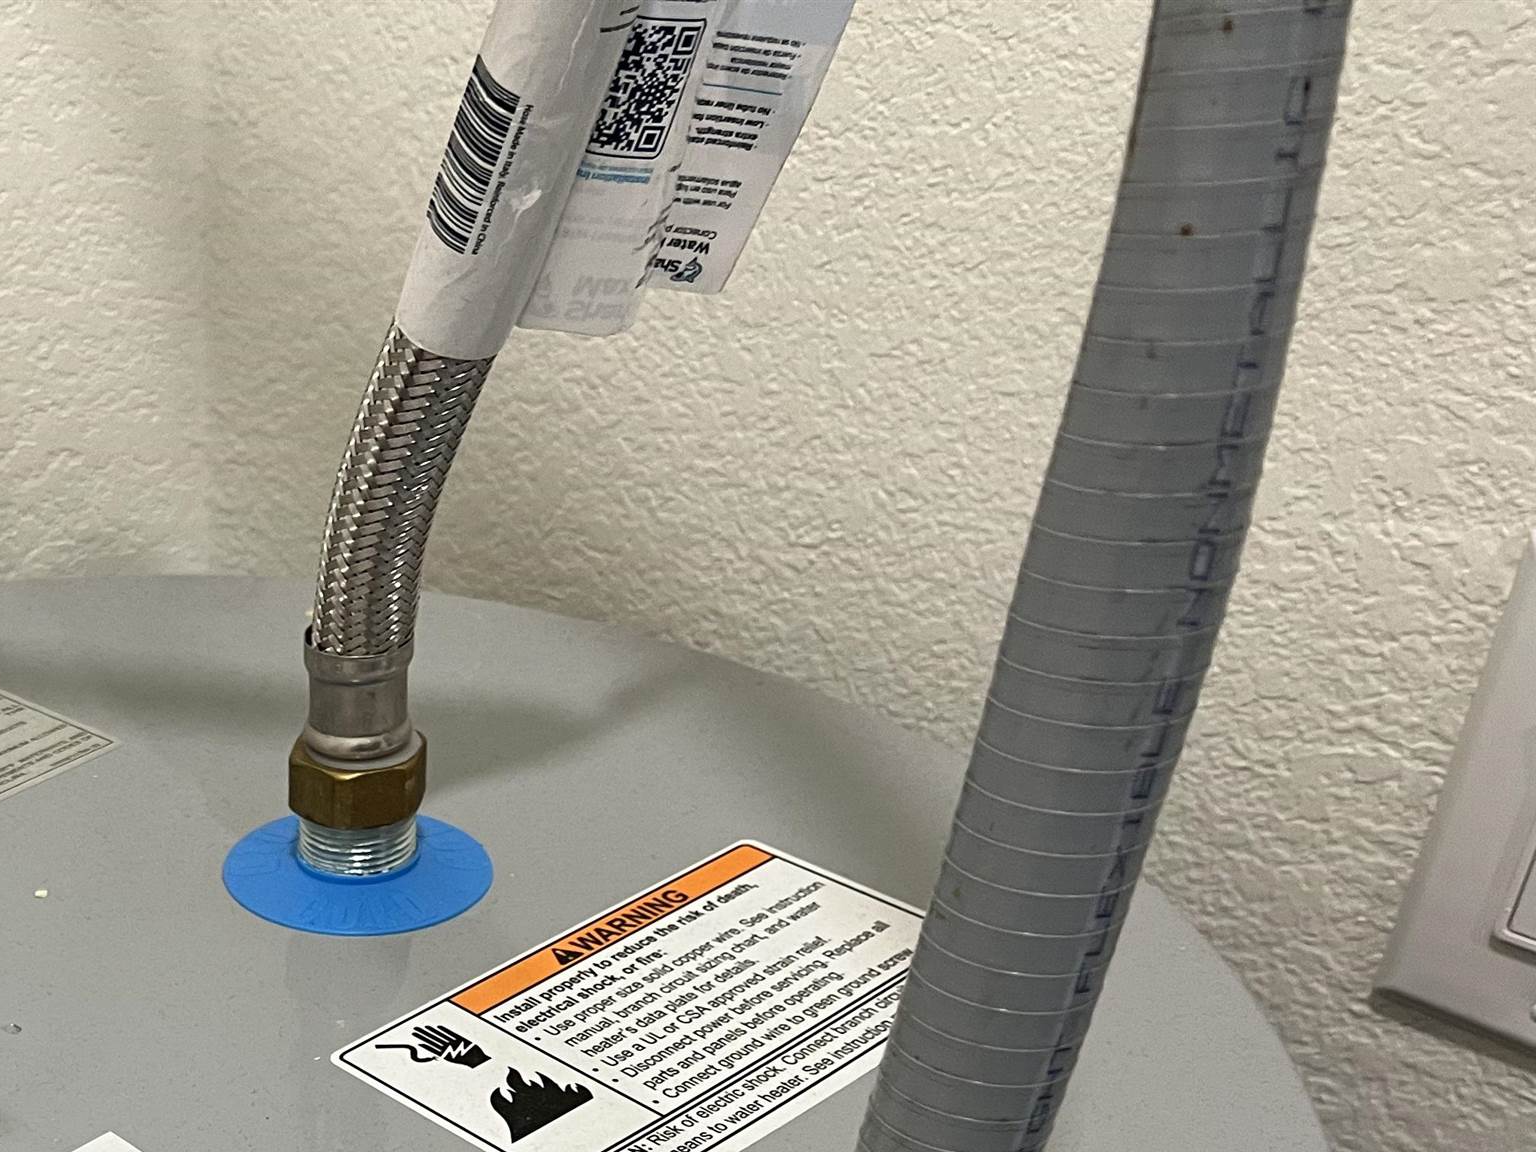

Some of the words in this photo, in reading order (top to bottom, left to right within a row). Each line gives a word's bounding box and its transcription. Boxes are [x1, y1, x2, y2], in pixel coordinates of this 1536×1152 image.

[667, 238, 710, 255] Water
[493, 996, 541, 1023] Install
[538, 967, 598, 1001] properly
[592, 959, 612, 969] to
[610, 935, 657, 961] reduce
[652, 923, 679, 937] the
[676, 910, 705, 925] risk
[701, 900, 719, 911] of
[716, 883, 759, 903] death,
[569, 889, 688, 950] WARNING
[795, 936, 831, 956] relief.
[515, 995, 579, 1032] electrical
[576, 974, 626, 999] shock,
[621, 963, 639, 974] or
[634, 948, 668, 965] fire:
[542, 1019, 576, 1035] Use
[573, 995, 616, 1022] proper
[615, 981, 644, 998] size
[641, 963, 674, 983] solid
[671, 941, 714, 966] copper
[711, 927, 744, 943] wire.
[738, 912, 769, 927] See
[762, 881, 825, 913] instruction
[564, 1016, 620, 1047] manual,
[611, 992, 662, 1018] branch
[659, 970, 699, 993] circuit
[695, 951, 736, 973] sizing
[730, 933, 769, 953] chart,
[763, 918, 790, 934] and
[786, 901, 820, 921] water
[707, 972, 765, 1007] approved
[762, 954, 799, 975] strain
[580, 1026, 638, 1057] heater's
[635, 1009, 668, 1027] data
[663, 992, 698, 1013] plate
[692, 980, 716, 993] for
[713, 959, 759, 982] details.
[620, 1034, 697, 1077] Disconnect
[692, 1012, 733, 1039] power
[727, 990, 773, 1014] before
[770, 959, 828, 991] servicing.
[821, 930, 875, 959] Replace
[871, 920, 890, 932] all
[642, 1067, 680, 1090] parts
[676, 1049, 706, 1069] and
[702, 1027, 747, 1055] panels
[739, 1004, 786, 1029] before
[783, 971, 844, 1005] operating.
[662, 1064, 721, 1098] Connect
[717, 1037, 765, 1069] ground
[760, 1023, 791, 1040] wire
[784, 1014, 805, 1025] to
[802, 993, 841, 1018] green
[836, 967, 881, 996] ground
[876, 948, 917, 970] screw
[662, 1022, 680, 1033] or
[675, 1005, 711, 1024] CSA
[600, 1049, 634, 1066] Use
[631, 1043, 646, 1051] a
[638, 1031, 667, 1044] UL
[646, 1125, 685, 1145] Risk
[680, 1113, 699, 1127] of
[696, 1088, 745, 1118] electric
[741, 1065, 786, 1090] shock.
[780, 1031, 838, 1065] Connect
[829, 1007, 878, 1034] branch
[874, 984, 903, 1009] circ
[706, 1122, 728, 1133] to
[723, 1099, 764, 1124] water
[757, 1074, 808, 1102] heater.
[801, 1057, 834, 1075] See
[827, 1020, 892, 1059] instruction
